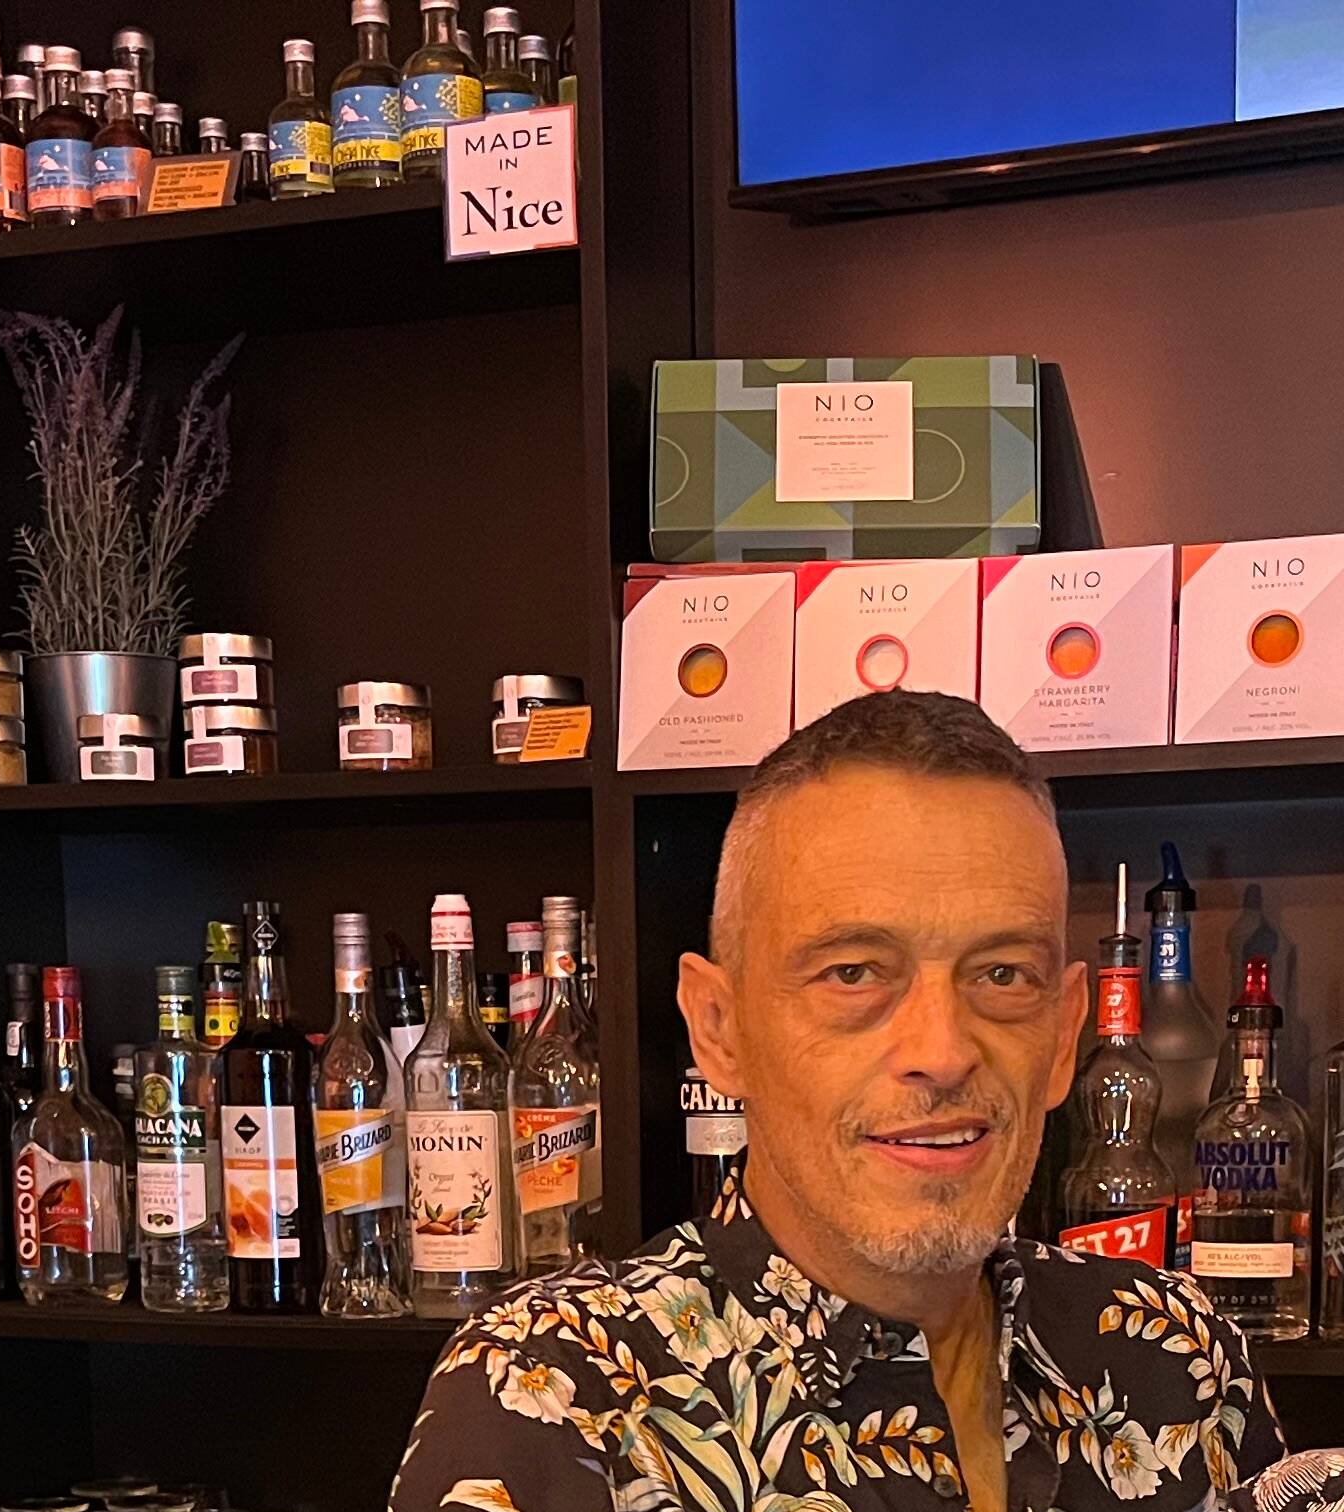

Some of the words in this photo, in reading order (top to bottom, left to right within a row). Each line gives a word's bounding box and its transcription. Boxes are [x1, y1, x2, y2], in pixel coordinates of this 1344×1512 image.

[464, 125, 553, 156] MADE
[499, 156, 518, 171] IN
[460, 185, 564, 237] Nice
[815, 394, 874, 412] NIO
[1252, 557, 1305, 578] NIO
[1050, 571, 1101, 591] NIO
[859, 584, 909, 603] NIO
[682, 594, 730, 615] NIO
[1034, 685, 1111, 698] STRAWBERRY
[1245, 685, 1301, 697] NEGRONI
[1038, 697, 1106, 709] MARGARITA
[658, 716, 681, 727] OLD
[340, 1123, 392, 1162] BRIZARD
[409, 1135, 484, 1152] MONIN
[537, 1122, 593, 1162] BRIZARD
[1194, 1140, 1291, 1167] ABSOLUT
[1200, 1166, 1278, 1191] VODKA
[15, 1164, 39, 1260] SOHO
[1061, 1229, 1109, 1259] ET
[1114, 1220, 1152, 1255] 27
